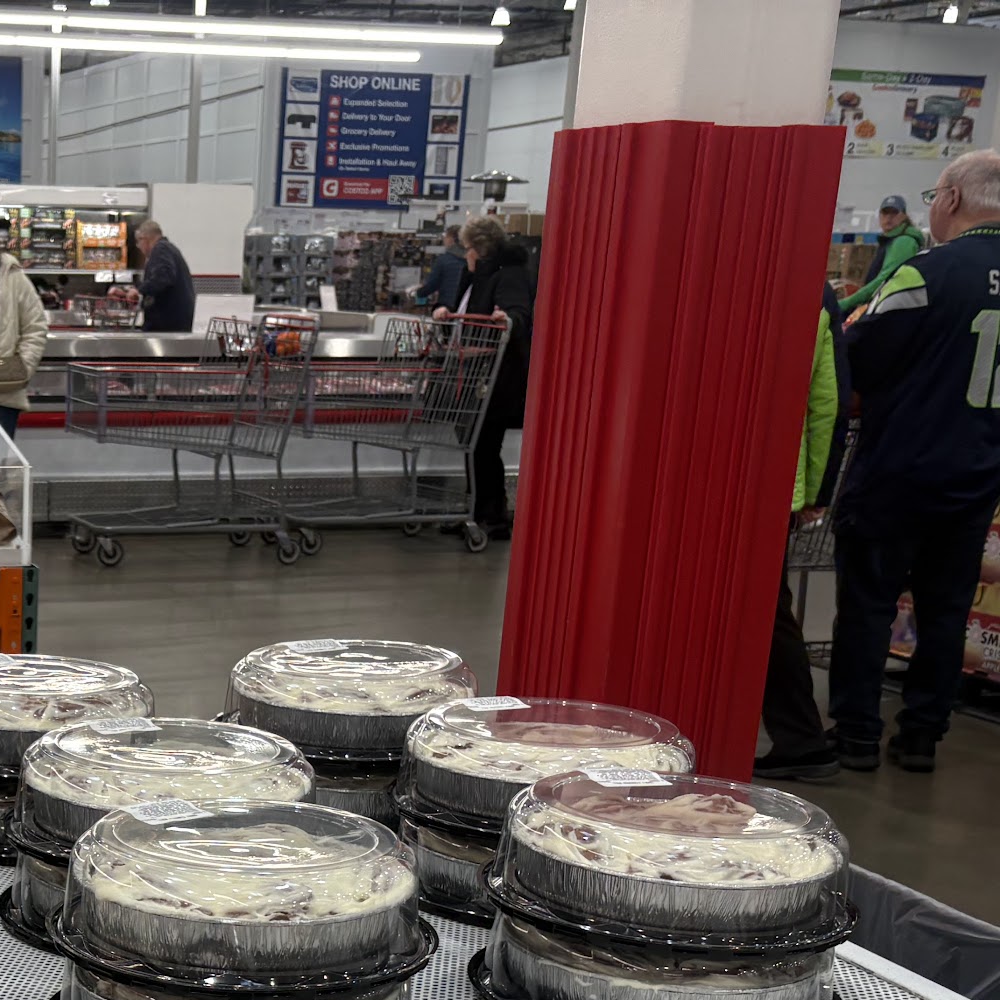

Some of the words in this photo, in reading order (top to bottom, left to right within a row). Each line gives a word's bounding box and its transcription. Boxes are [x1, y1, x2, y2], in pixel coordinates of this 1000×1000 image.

[330, 74, 369, 89] SHOP
[371, 76, 421, 91] ONLINE
[343, 99, 376, 108] Expanded
[377, 100, 408, 108] Selection
[342, 113, 369, 122] Delivery
[340, 127, 368, 136] Grocery
[368, 129, 396, 137] Delivery
[340, 142, 370, 151] Exclusive
[372, 144, 410, 152] Promotions
[847, 142, 855, 154] 2
[886, 143, 894, 155] 3
[941, 145, 949, 157] 4
[339, 157, 375, 166] Installation
[989, 269, 1000, 296] S
[980, 630, 1000, 647] SM
